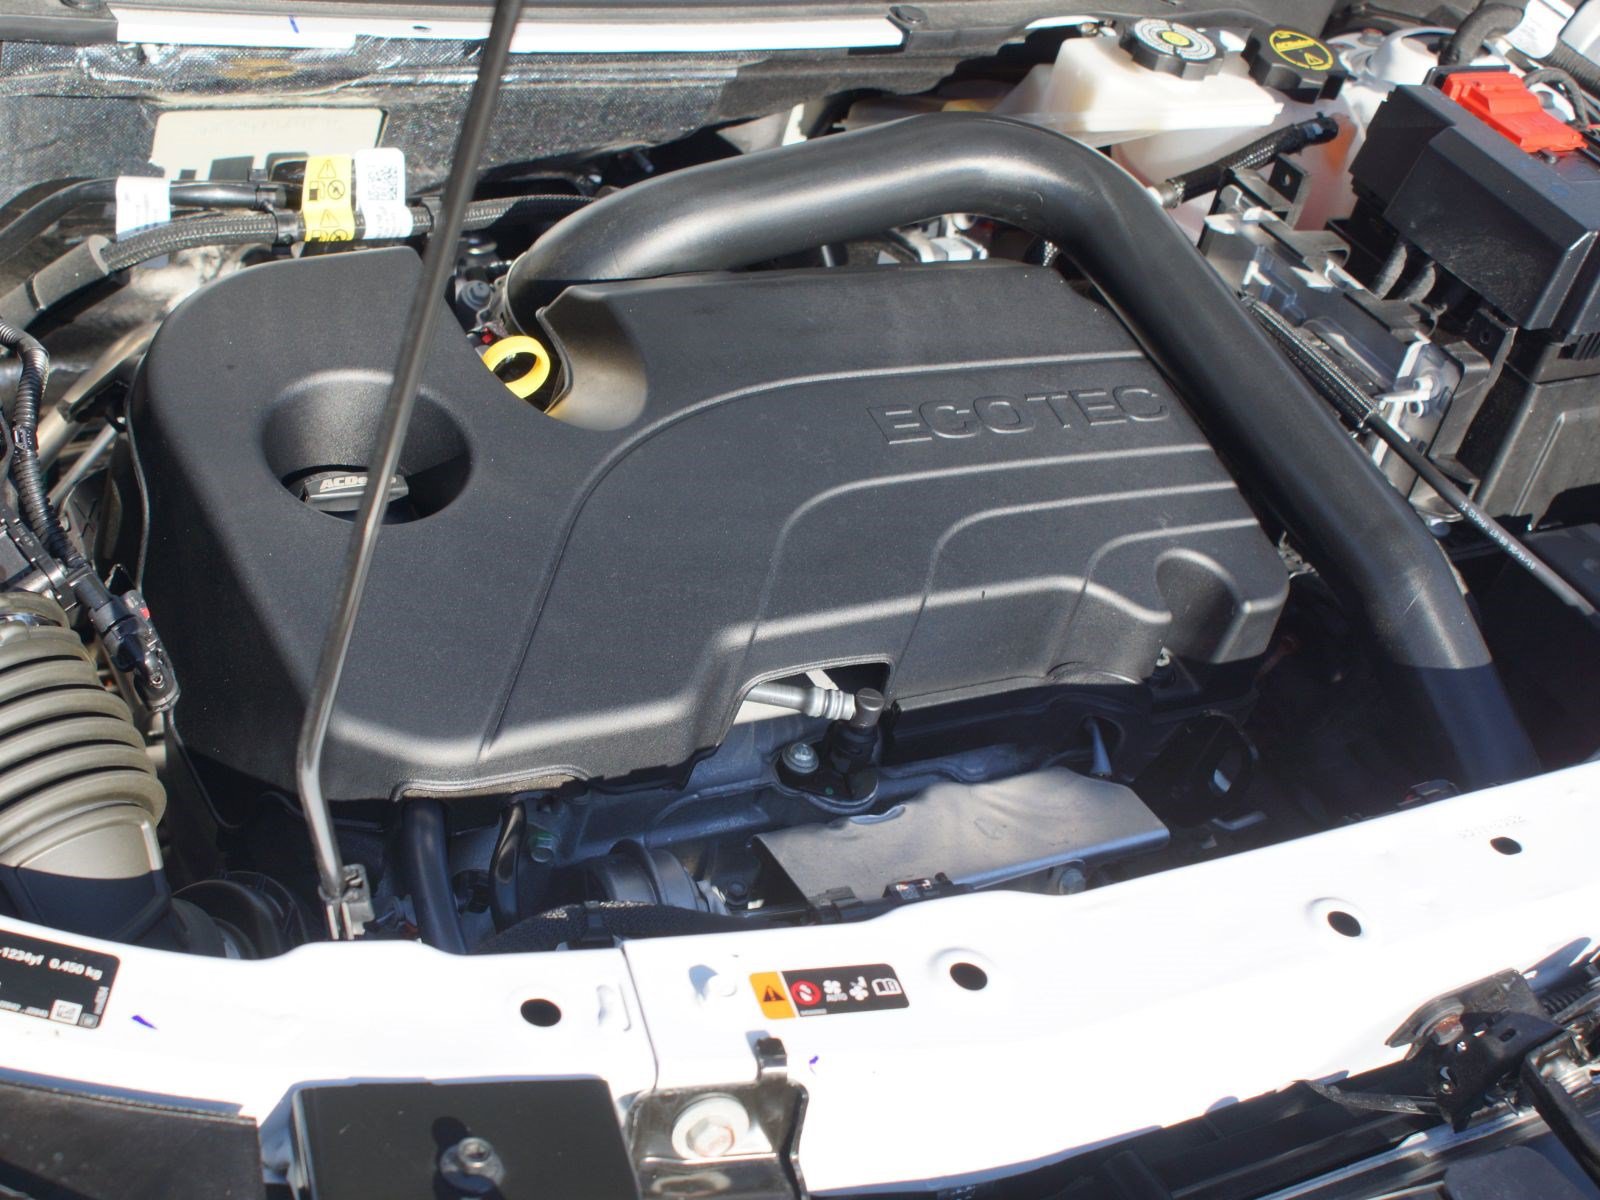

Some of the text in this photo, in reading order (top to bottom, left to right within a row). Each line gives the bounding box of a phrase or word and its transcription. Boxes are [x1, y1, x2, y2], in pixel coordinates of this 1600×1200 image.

[866, 384, 1169, 445] ECOTEC
[319, 475, 398, 490] ACDe
[85, 965, 103, 981] kg
